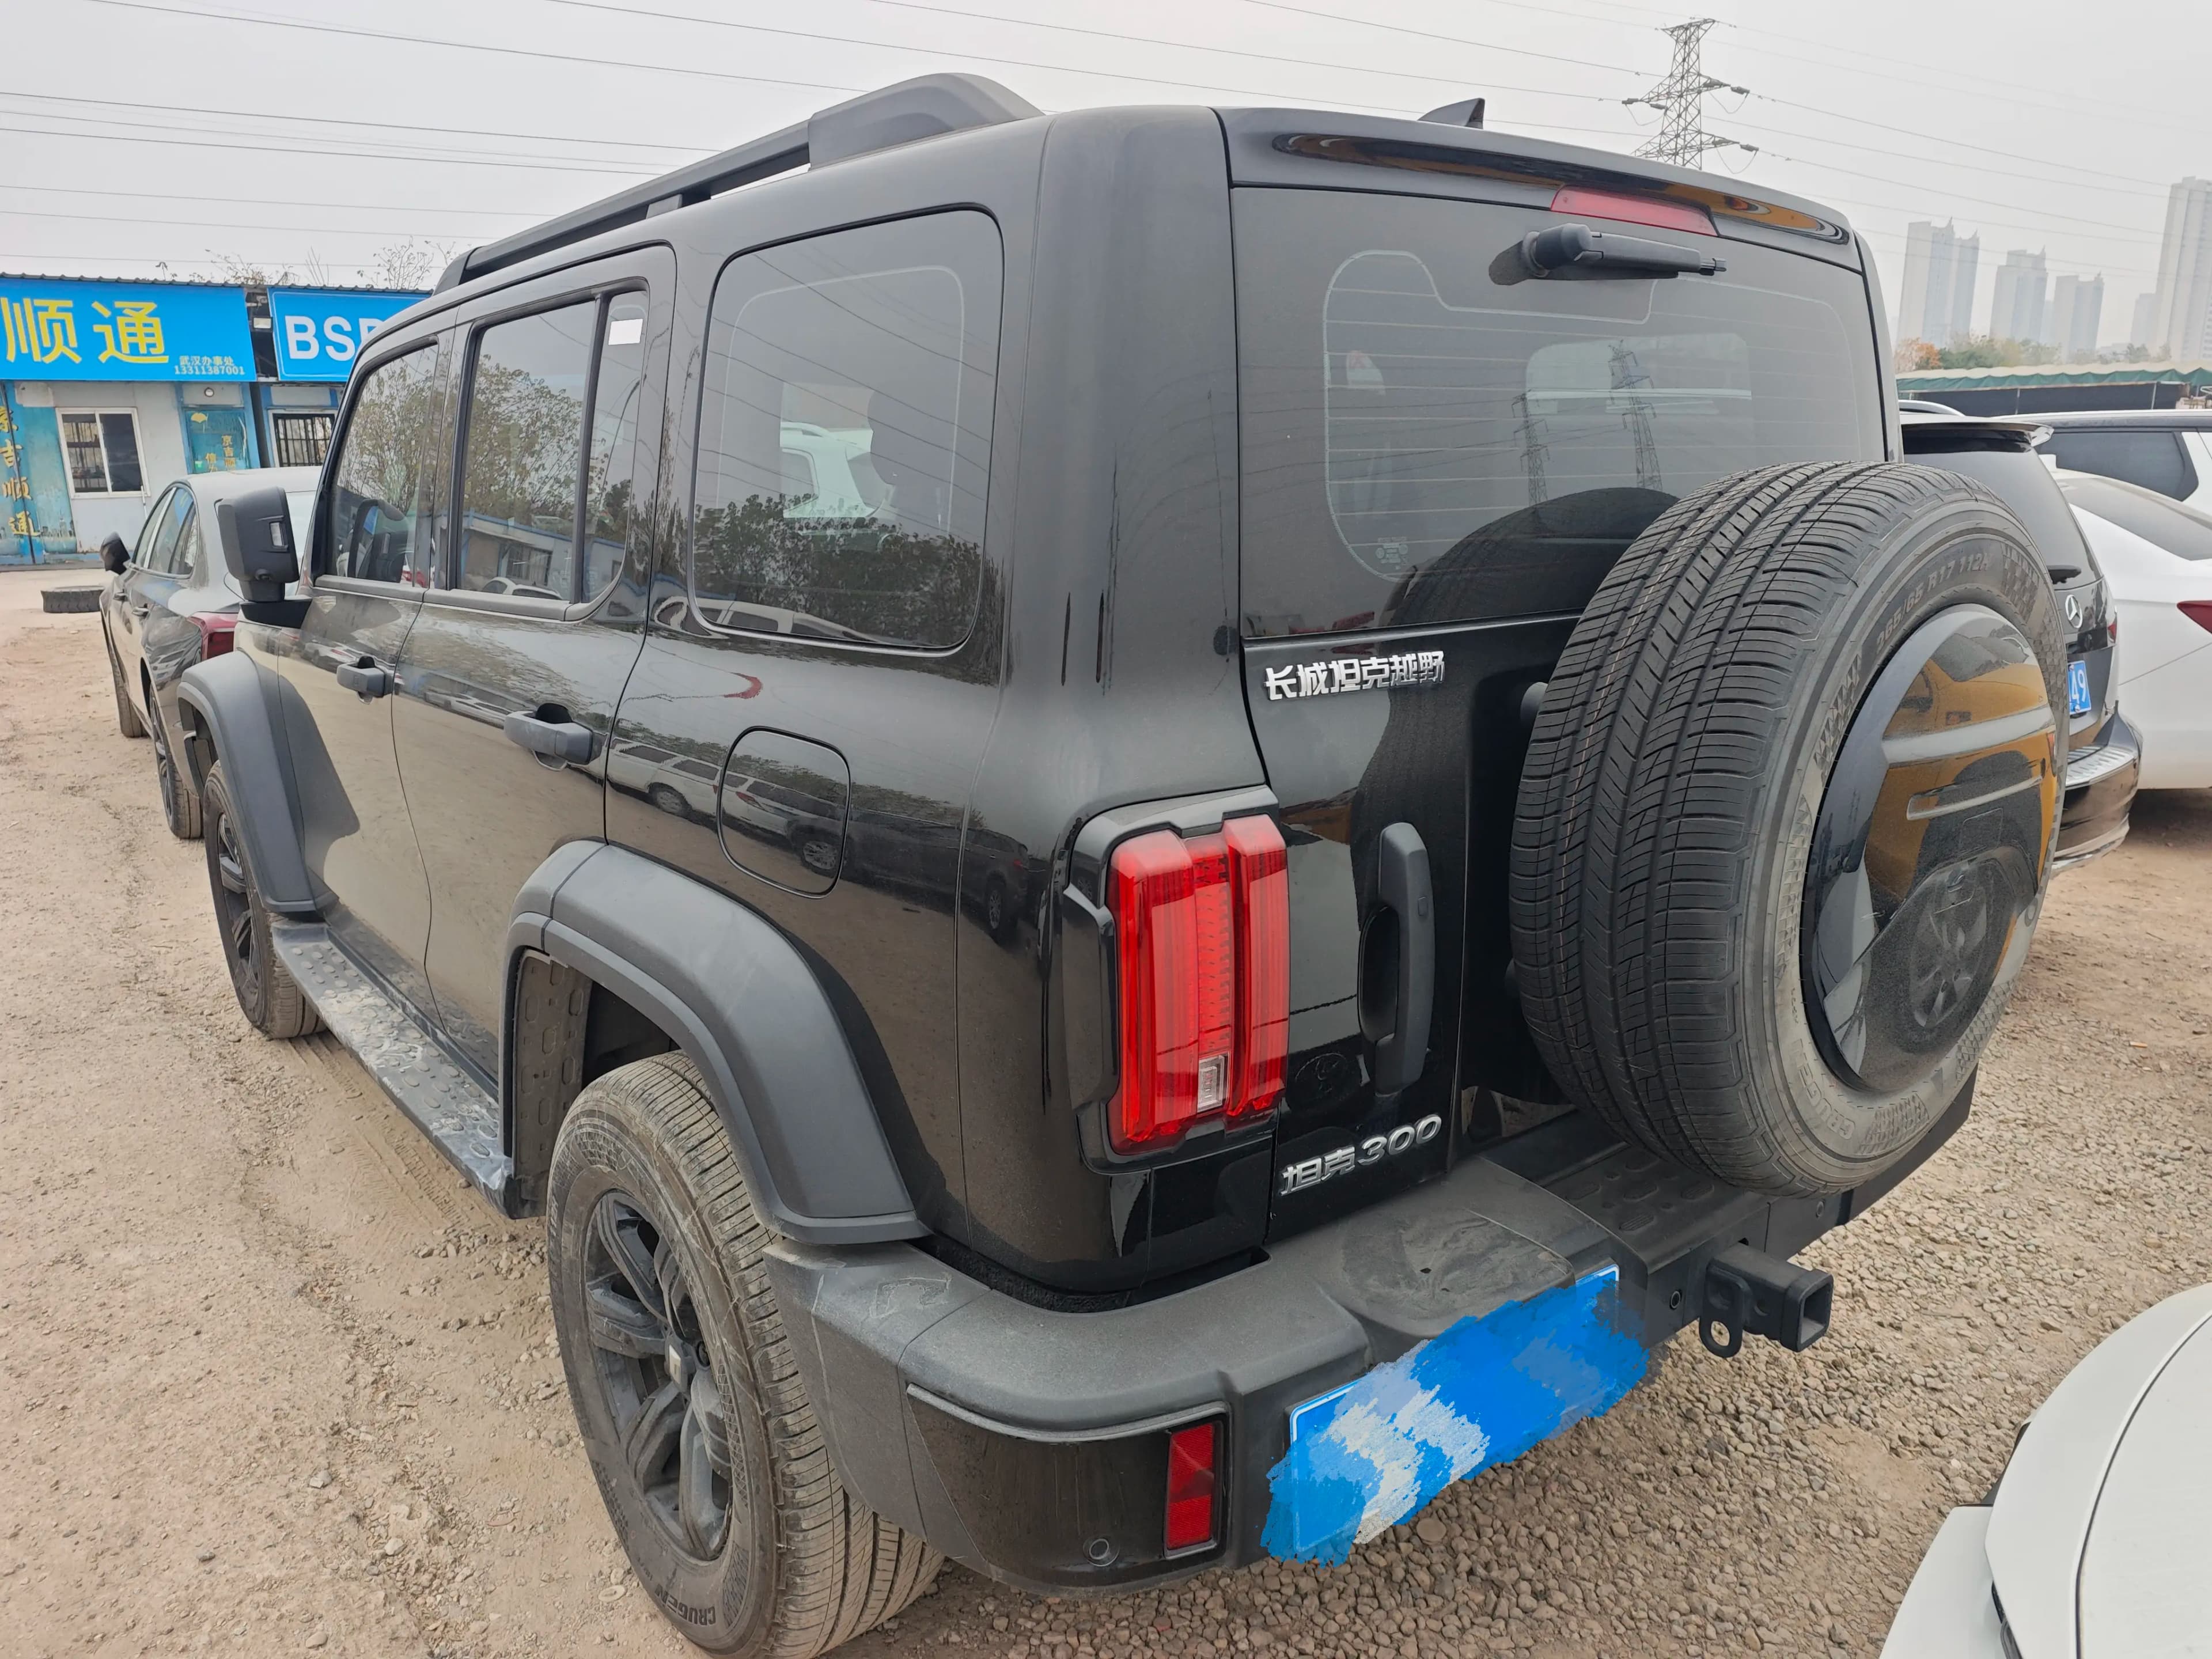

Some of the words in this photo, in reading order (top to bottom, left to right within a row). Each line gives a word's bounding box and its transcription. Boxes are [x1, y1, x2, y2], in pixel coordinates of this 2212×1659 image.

[0, 297, 169, 363] 顺通
[1264, 650, 1445, 700] 长城坦克越野
[2069, 670, 2086, 704] 49
[654, 1584, 717, 1626] CRUGEN
